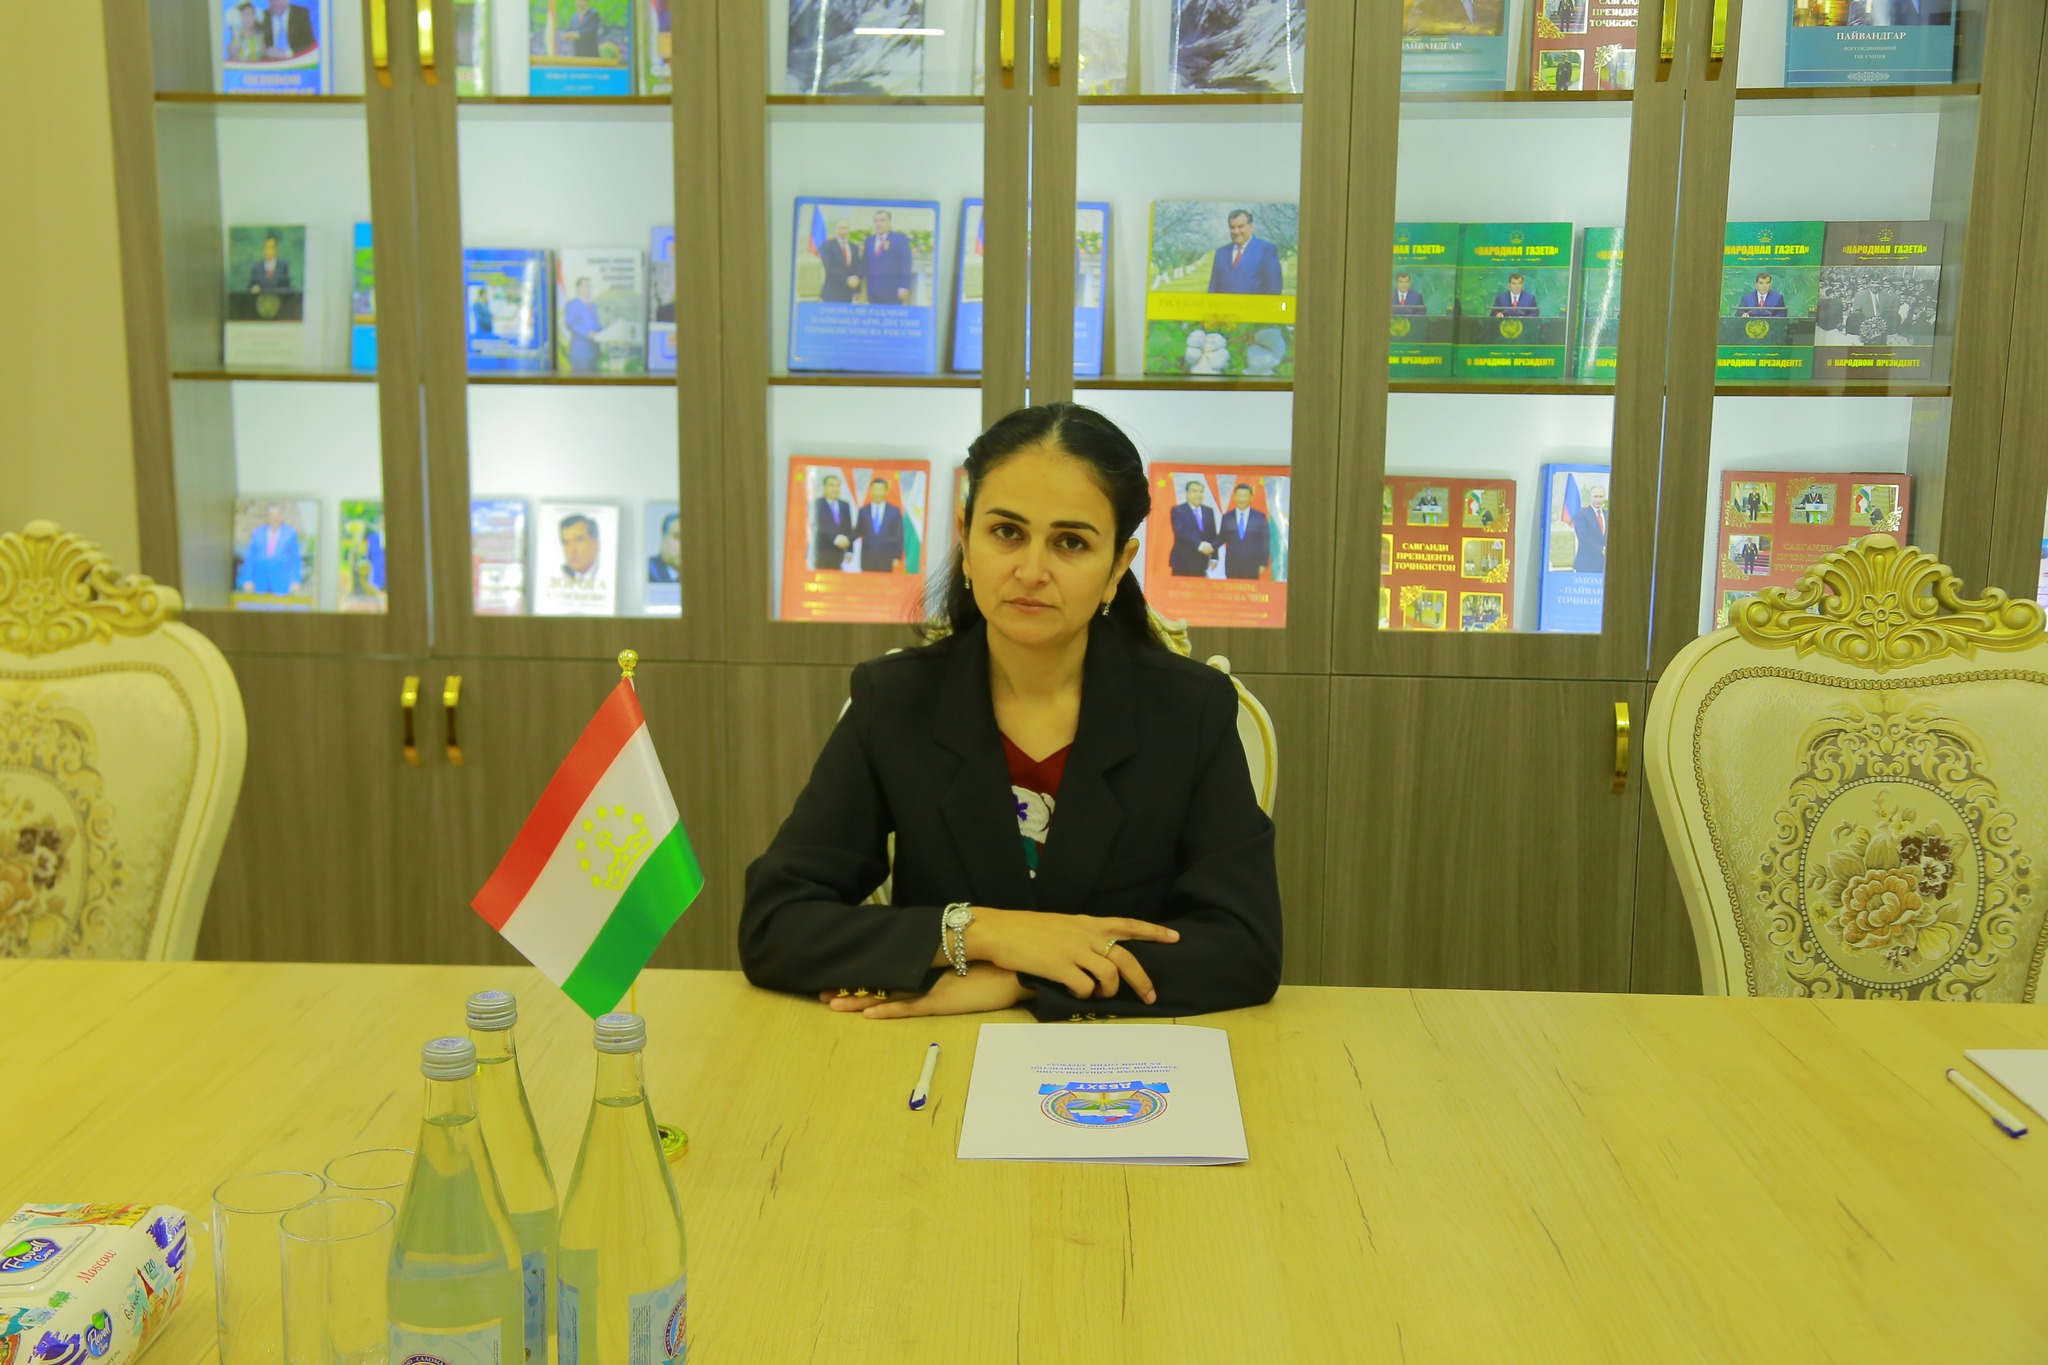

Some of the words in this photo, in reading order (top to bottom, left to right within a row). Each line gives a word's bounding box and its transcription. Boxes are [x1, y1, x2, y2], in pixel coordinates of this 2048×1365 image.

[1836, 31, 1907, 40] ПАЙВАНДГАР
[1412, 244, 1445, 254] ГАЗЕТА»
[1474, 246, 1522, 256] «НАРОДНАЯ
[1525, 246, 1559, 256] ГАЗЕТА»
[1774, 244, 1809, 254] ГАЗЕТА»
[1842, 245, 1890, 255] «НАРОДНАЯ
[1894, 244, 1928, 254] ГАЗЕТА»
[1401, 356, 1442, 365] ПРЕЗИДЕНТЕ
[1474, 358, 1511, 366] НАРОДНОМ
[1513, 358, 1555, 367] ПРЕЗИДЕНТЕ
[1717, 359, 1756, 368] НАРОДНОМ
[1759, 359, 1803, 368] ПРЕЗИДЕНТЕ
[1834, 359, 1874, 367] НАРОДНОМ
[1876, 359, 1920, 368] ПРЕЗИДЕНТЕ
[1402, 542, 1449, 552] САВГАНДИ
[1396, 552, 1454, 562] ПРЕЗИДЕНТИ
[76, 1250, 116, 1283] Moscow
[143, 1259, 156, 1275] 120
